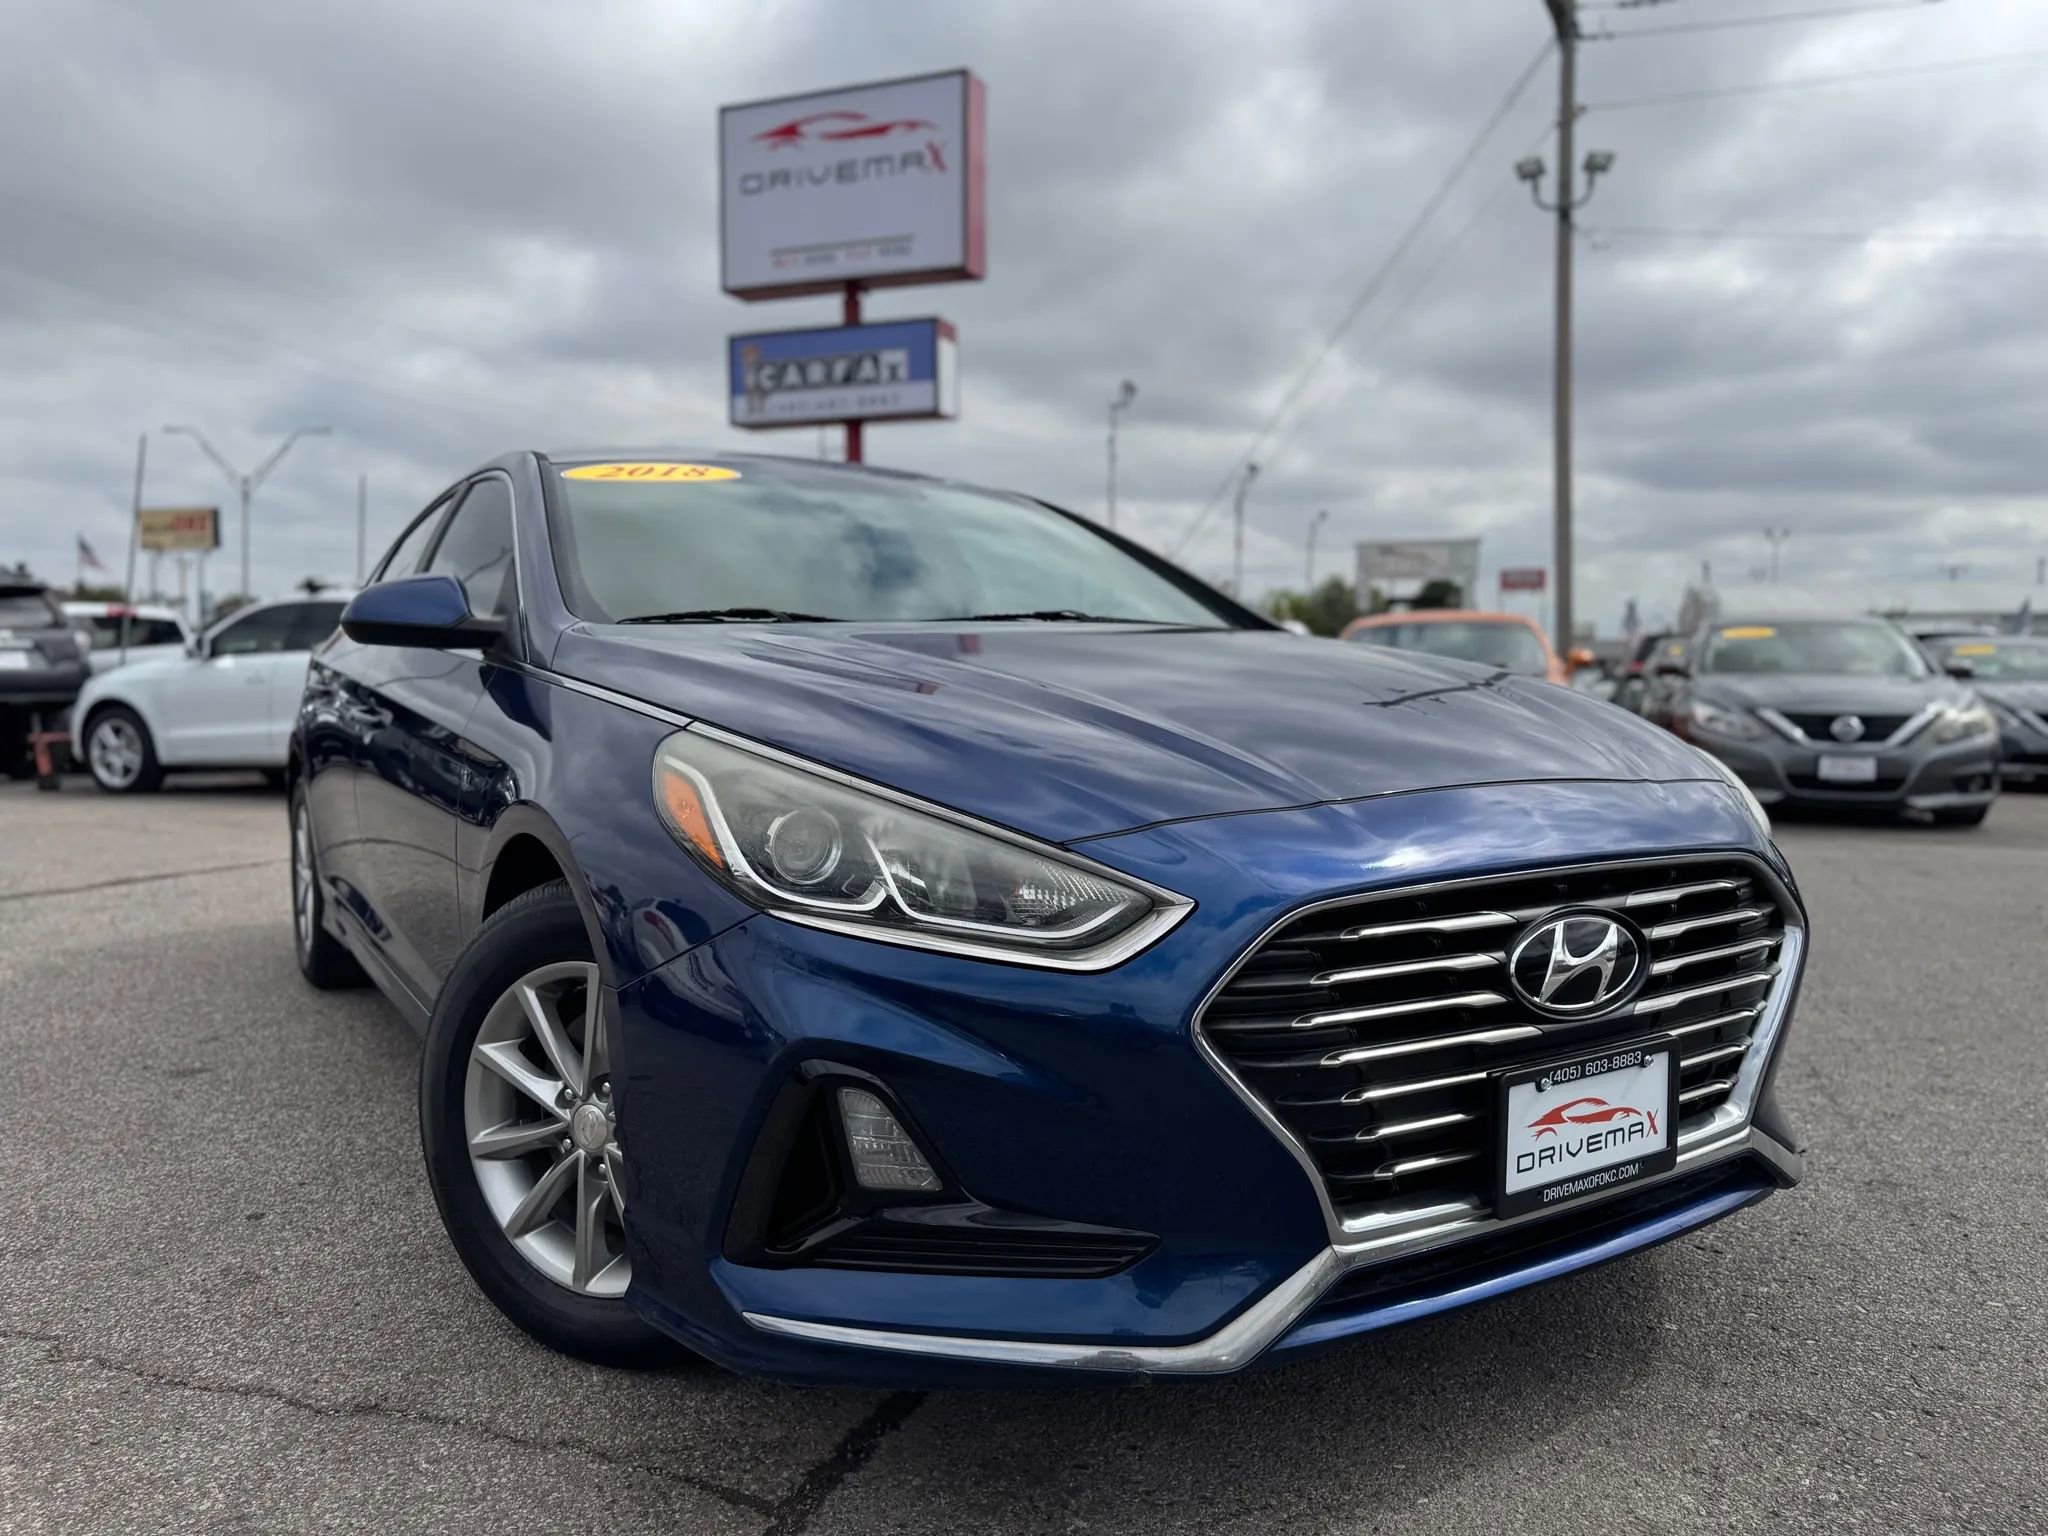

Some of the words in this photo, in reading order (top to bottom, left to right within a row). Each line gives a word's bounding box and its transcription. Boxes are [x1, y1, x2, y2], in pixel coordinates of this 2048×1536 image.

[738, 138, 948, 197] DRIVEMAX
[595, 466, 710, 478] 2018
[1549, 1065, 1581, 1085] (405)
[1585, 1051, 1642, 1076] 603-8883
[1516, 1108, 1659, 1174] DRIVEMAX
[1543, 1164, 1640, 1202] DRIVEMAXOFOKC.COM
